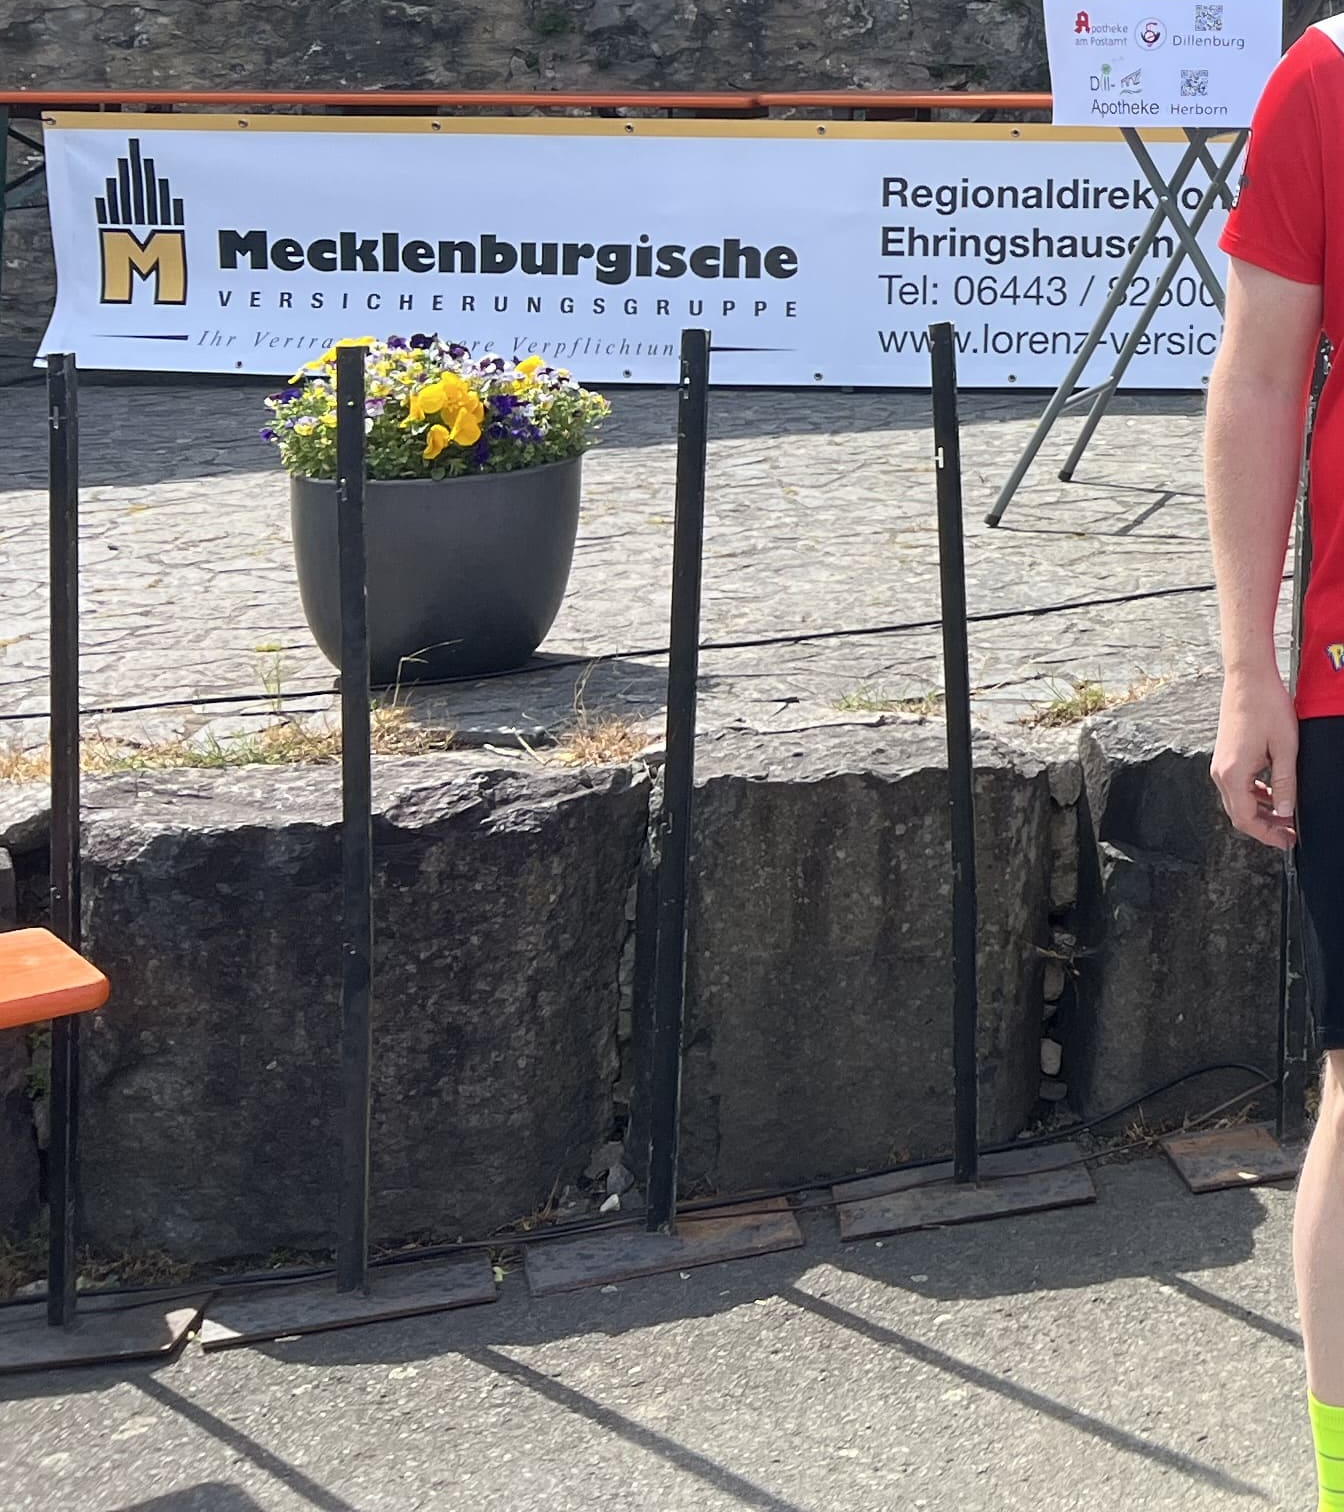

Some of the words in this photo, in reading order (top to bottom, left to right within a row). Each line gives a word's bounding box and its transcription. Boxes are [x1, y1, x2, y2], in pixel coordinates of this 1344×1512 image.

[1090, 36, 1128, 47] Postamt
[1172, 34, 1246, 50] Dillenburg
[1091, 98, 1160, 118] Apotheke
[1170, 103, 1229, 116] Herborn
[881, 176, 1232, 216] Regionaldireko
[218, 229, 799, 285] Mecklenburgische
[880, 226, 1174, 265] Ehringshausen
[218, 289, 798, 319] VERSICHERUNGSGRUPPE
[878, 274, 939, 306] Tel:
[954, 275, 1068, 307] 06443
[1079, 275, 1096, 307] /
[197, 329, 237, 347] Ihr
[254, 331, 334, 349] Vertra
[511, 336, 681, 360] Verpflichtun
[878, 323, 1224, 356] www.lorenz-versic
